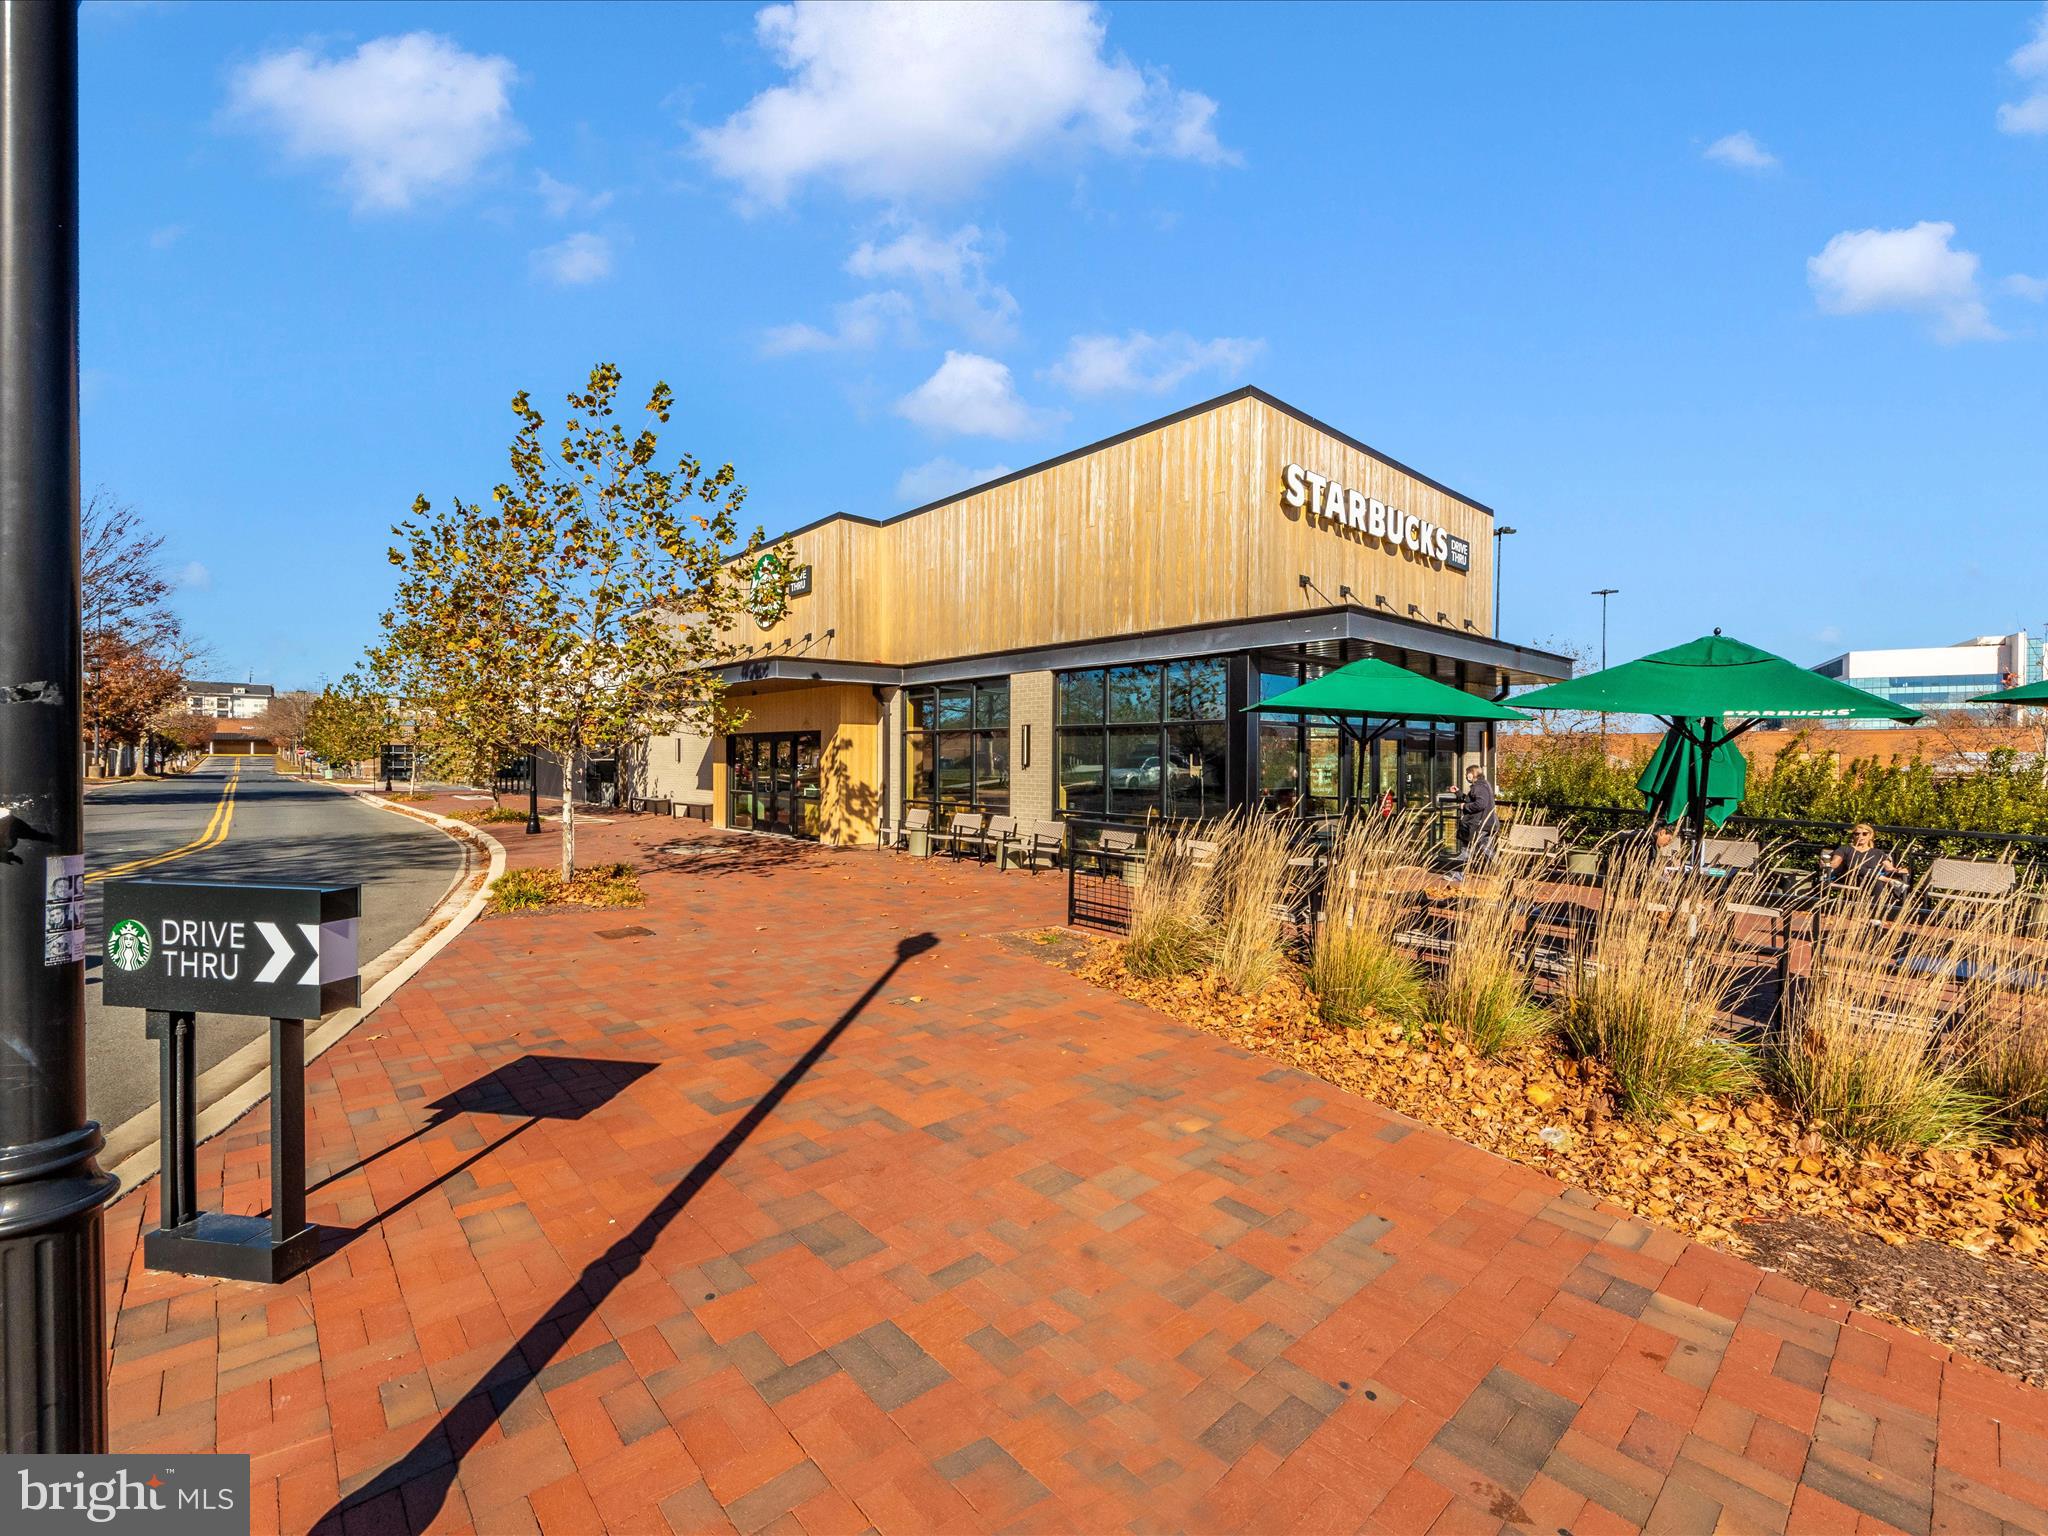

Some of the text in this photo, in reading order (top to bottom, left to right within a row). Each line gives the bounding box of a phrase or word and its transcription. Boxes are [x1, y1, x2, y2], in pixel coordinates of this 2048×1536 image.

[1284, 463, 1448, 561] STARBUCKS
[1451, 539, 1468, 555] DRIVE
[1451, 550, 1467, 566] THRU
[1722, 708, 1851, 717] STARBUCKS
[161, 919, 246, 949] DRIVE
[162, 950, 239, 981] THRU
